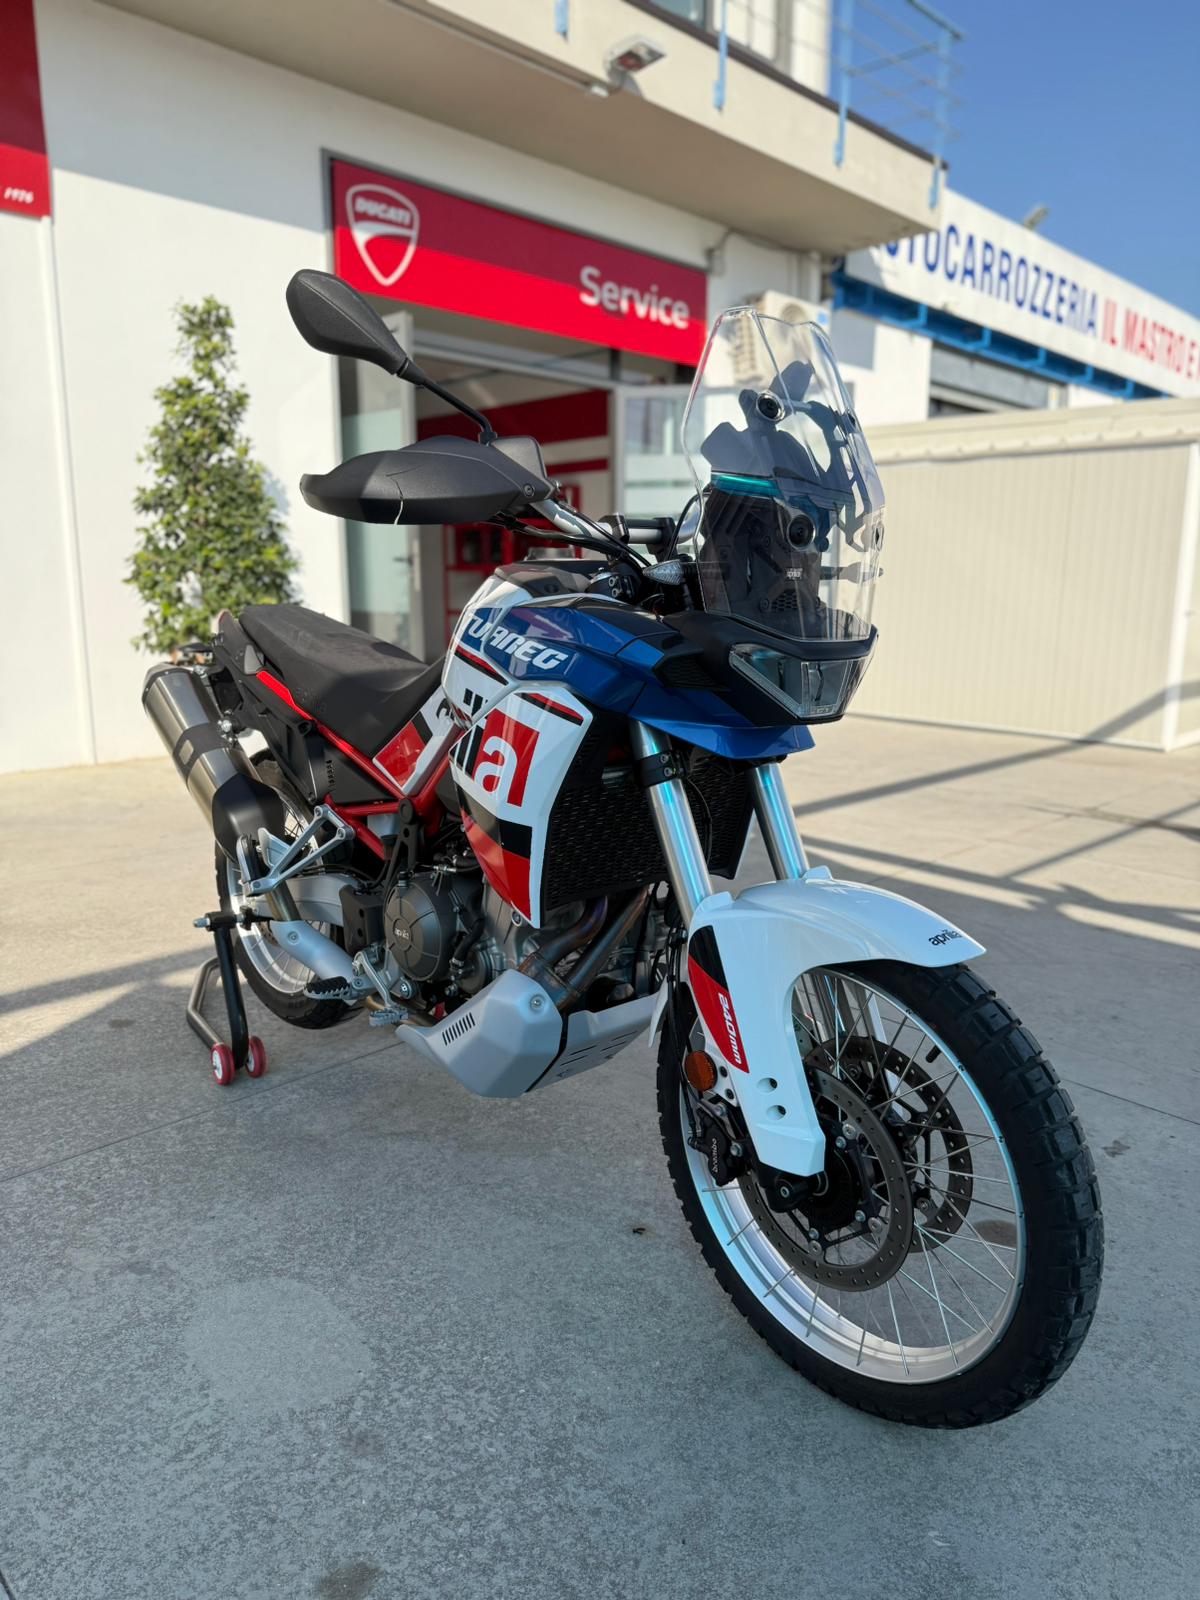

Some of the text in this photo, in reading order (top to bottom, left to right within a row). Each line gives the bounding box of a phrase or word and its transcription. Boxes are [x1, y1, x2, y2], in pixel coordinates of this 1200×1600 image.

[355, 196, 411, 226] DUCATI
[579, 265, 690, 329] Service
[928, 929, 962, 946] aprilia
[718, 992, 742, 1065] 240mm
